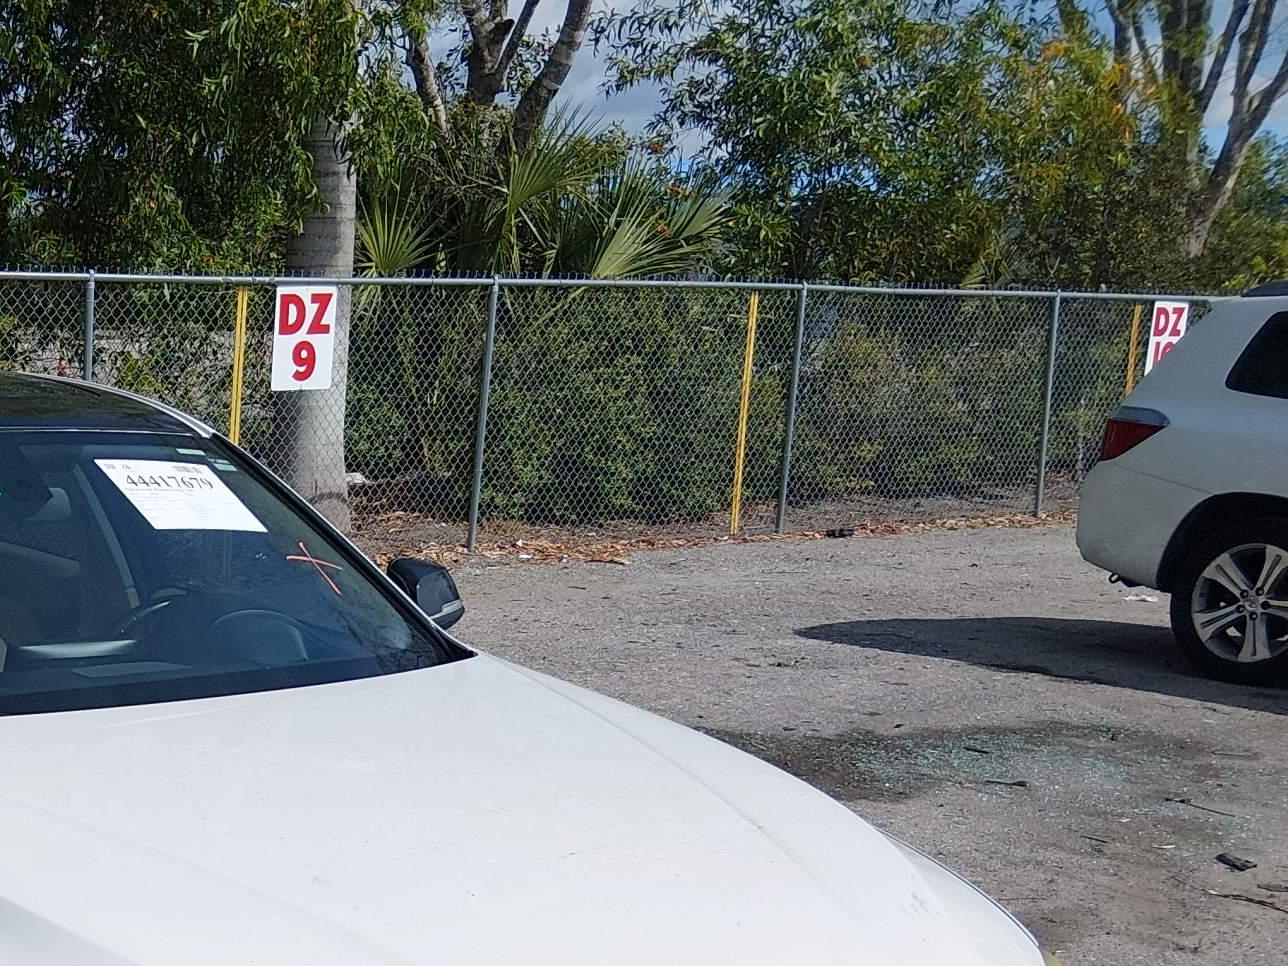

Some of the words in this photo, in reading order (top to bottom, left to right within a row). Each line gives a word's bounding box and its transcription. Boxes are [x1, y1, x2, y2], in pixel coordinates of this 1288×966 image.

[278, 293, 333, 335] DZ
[1153, 307, 1186, 337] DZ
[292, 340, 316, 382] 9
[125, 474, 214, 490] 44417679
